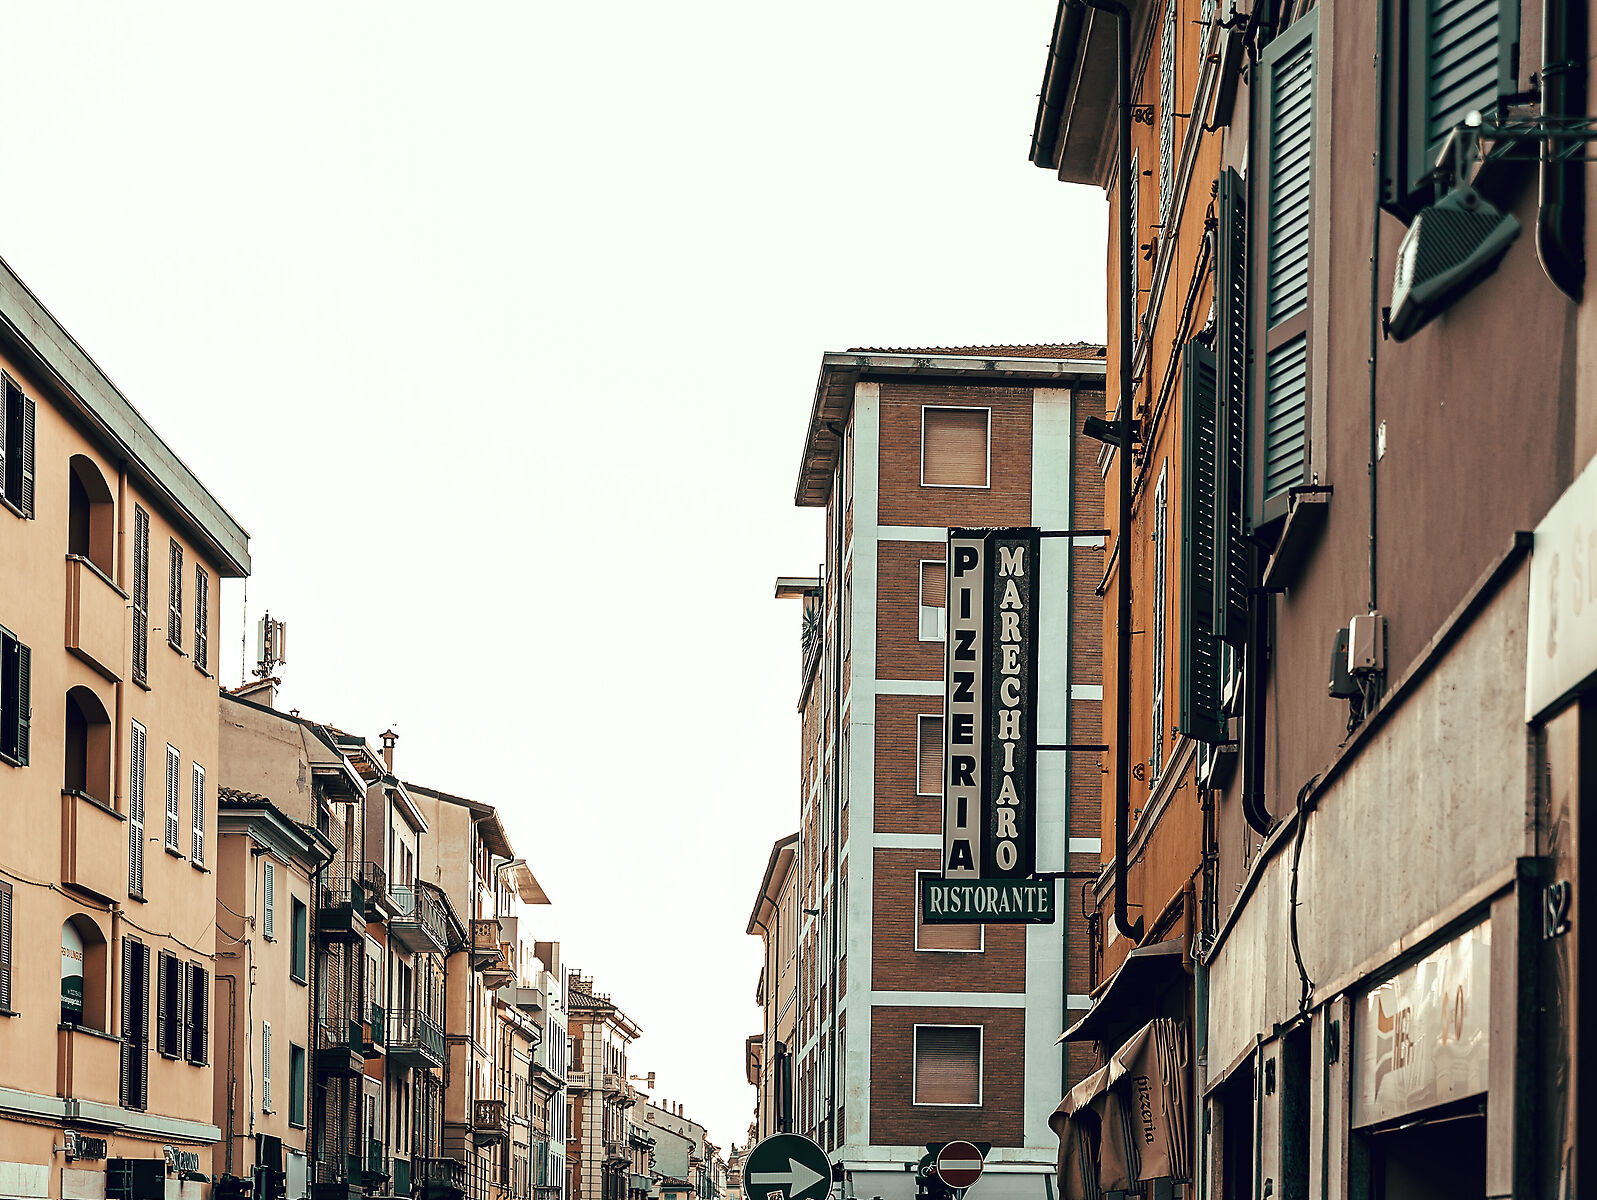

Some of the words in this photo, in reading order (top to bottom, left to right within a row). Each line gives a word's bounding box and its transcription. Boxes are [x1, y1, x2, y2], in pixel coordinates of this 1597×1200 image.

[948, 547, 979, 871] PIZZERIA
[995, 546, 1025, 871] MARECHIARO
[930, 886, 1048, 915] RISTORANTE
[1133, 1074, 1156, 1145] pizzeria
